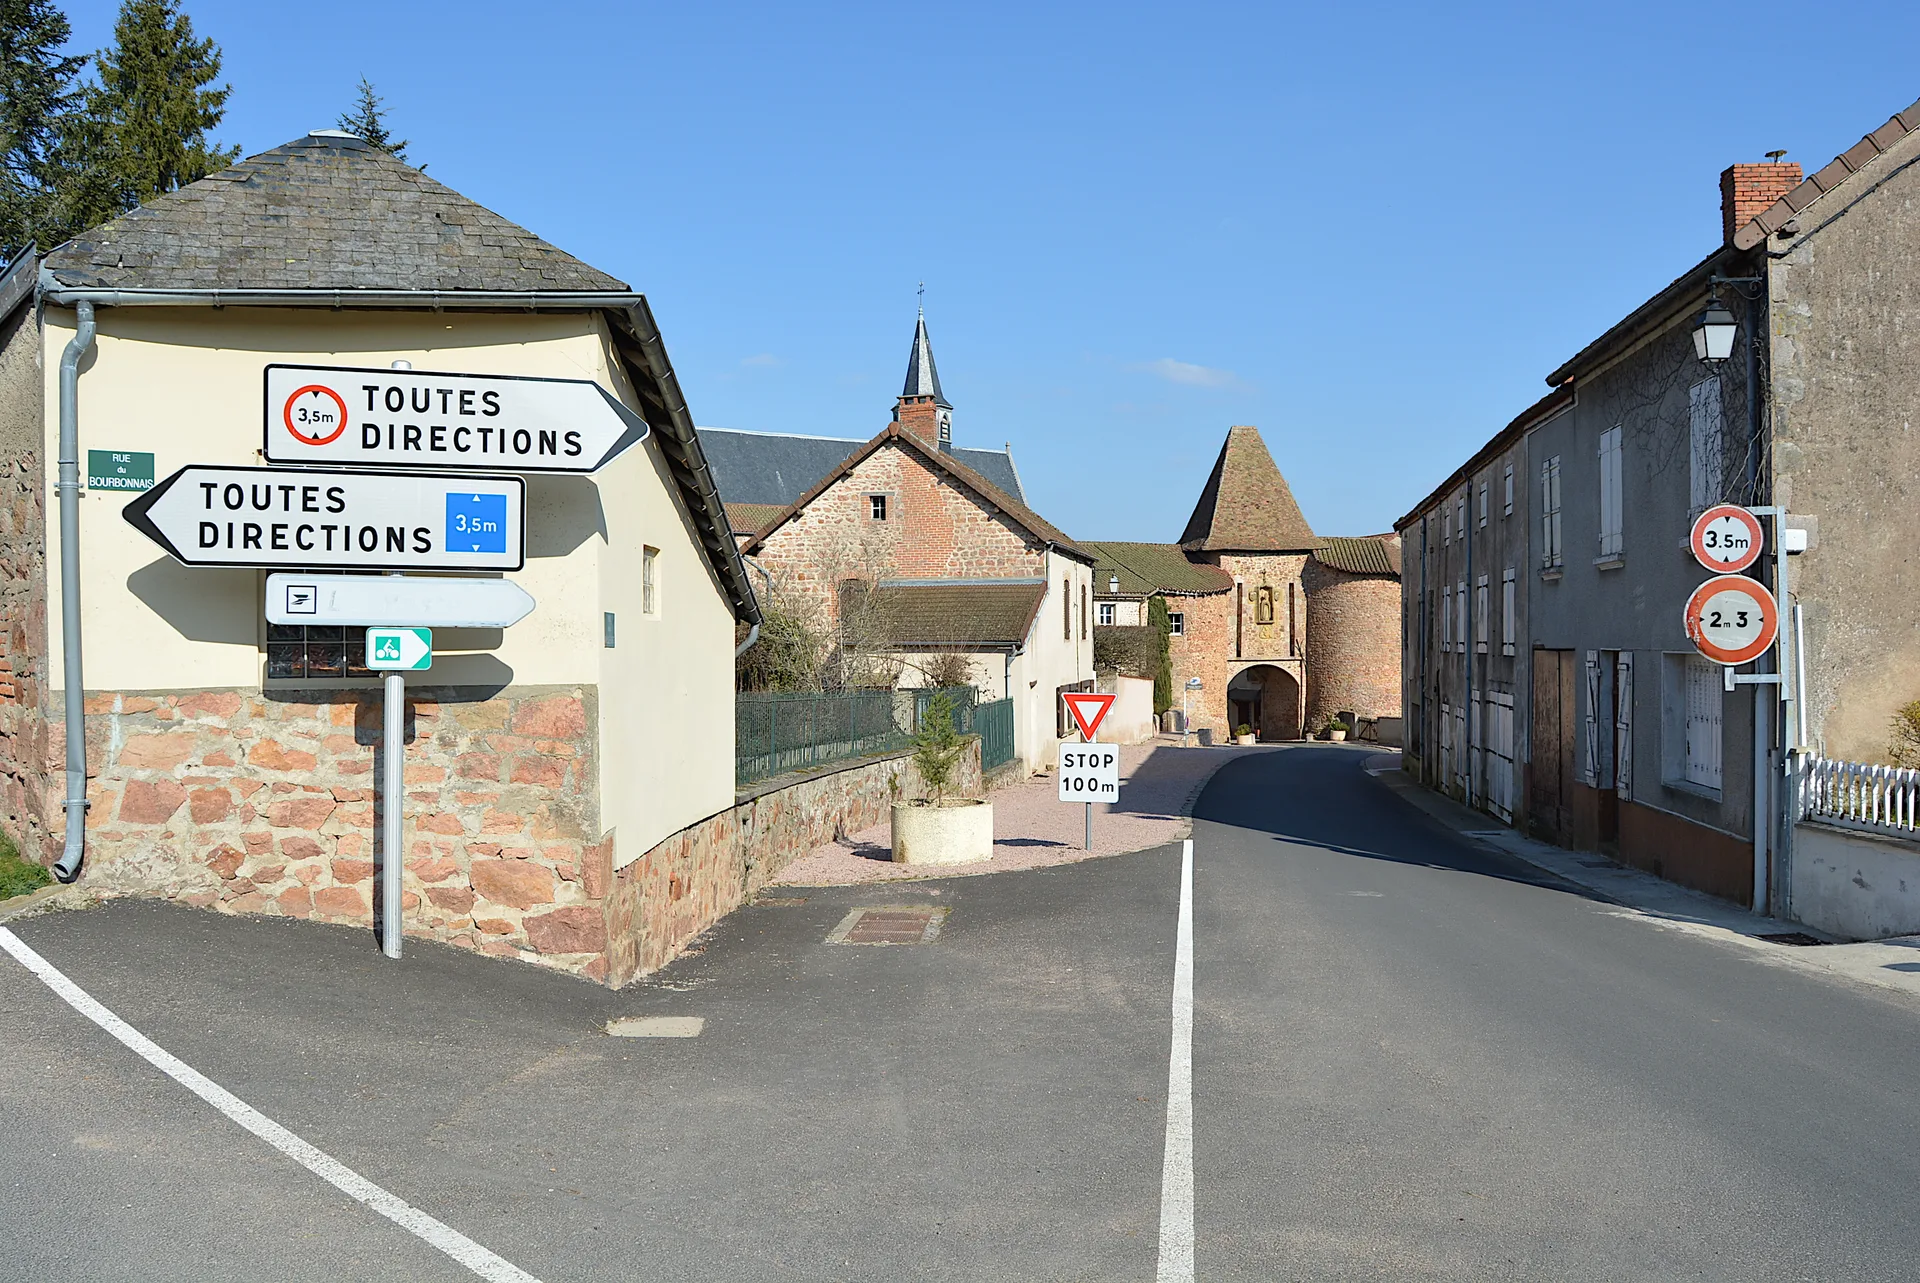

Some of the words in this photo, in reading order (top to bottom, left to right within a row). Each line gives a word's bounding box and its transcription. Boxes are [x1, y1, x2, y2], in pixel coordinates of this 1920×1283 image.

[361, 384, 502, 417] TOUTES
[298, 408, 334, 425] 3,5m
[361, 423, 582, 456] DIRECTIONS
[112, 453, 131, 463] RUE
[117, 466, 126, 474] du
[89, 477, 153, 489] BOURBONNAIS
[199, 482, 346, 514] TOUTES
[455, 514, 497, 534] 3,5m
[199, 521, 432, 554] DIRECTIONS
[1705, 531, 1748, 549] 3.5m
[1064, 753, 1114, 768] STOP
[1063, 777, 1114, 792] 100m
